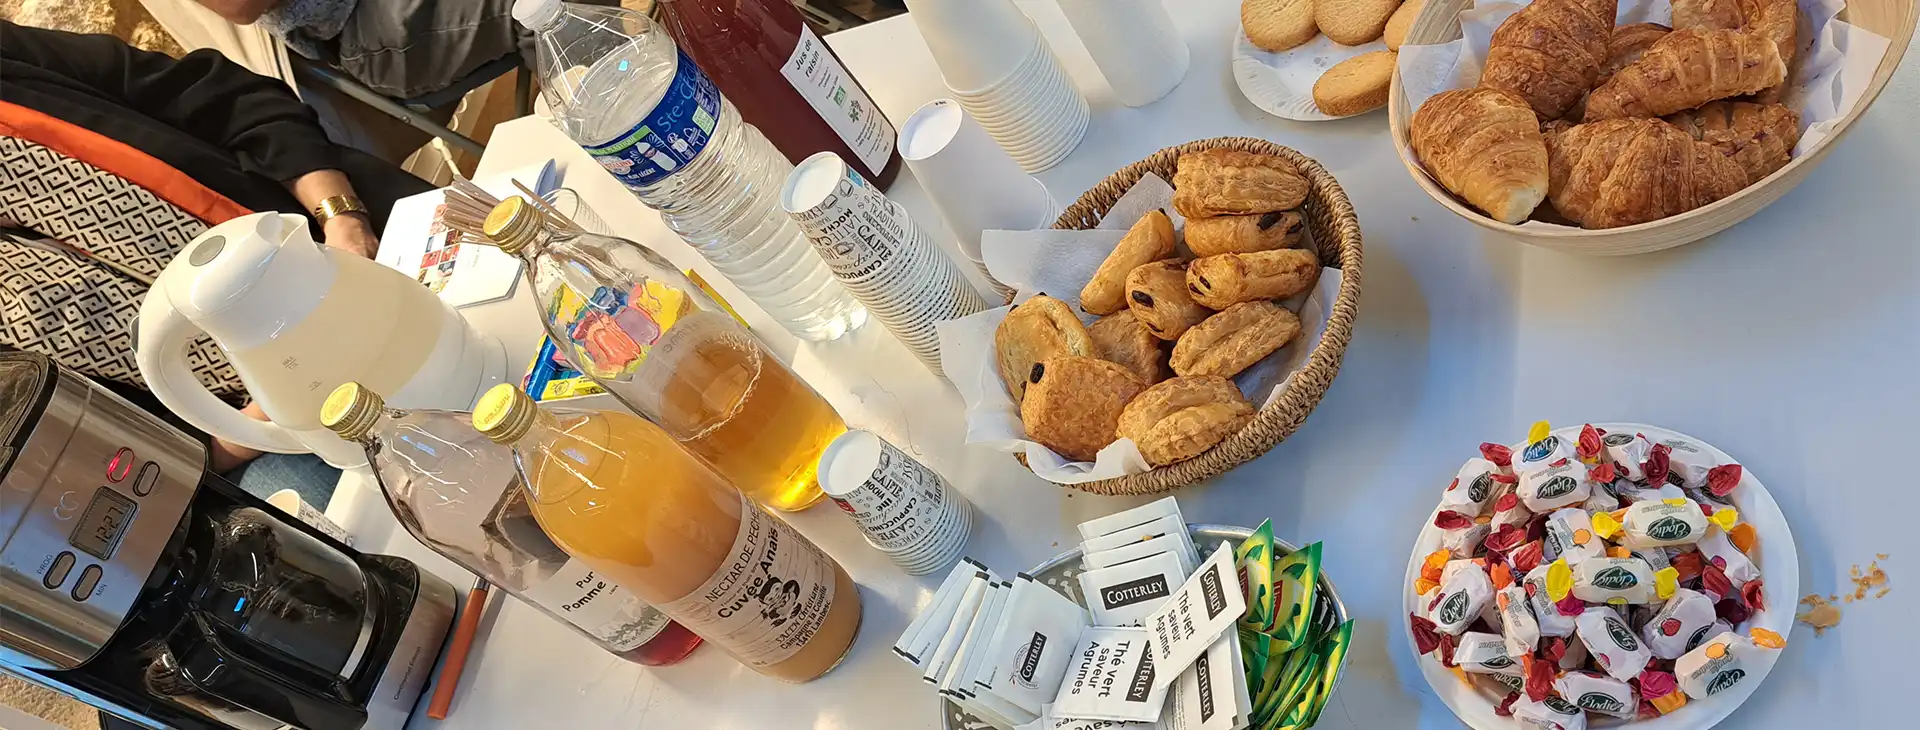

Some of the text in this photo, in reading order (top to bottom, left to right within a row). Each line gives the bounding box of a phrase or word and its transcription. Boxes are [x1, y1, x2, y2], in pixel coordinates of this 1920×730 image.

[795, 39, 812, 70] Jus de
[805, 50, 820, 78] raisin
[820, 208, 853, 234] MOCHA
[832, 214, 862, 242] LATTE
[837, 259, 882, 279] CAPPUCC
[863, 480, 886, 500] MOCHA
[96, 506, 124, 544] 12:27
[869, 497, 917, 532] CAPPUCCINO
[1650, 521, 1690, 541] Elodie
[885, 526, 925, 548] EXPRESSO
[37, 554, 53, 575] PROG
[705, 563, 745, 603] NECTAR
[739, 545, 753, 565] DE
[748, 507, 761, 547] PECHE
[576, 571, 595, 589] Pur
[718, 577, 764, 618] Cuvée
[760, 527, 779, 575] Anaïs
[1596, 571, 1637, 590] Elodie
[95, 583, 107, 597] MIN
[562, 580, 607, 613] Pomme
[799, 583, 820, 621] Christiane
[1107, 581, 1164, 605] COTTERLEY
[1203, 569, 1222, 614] COTTERLEY
[780, 620, 812, 650] Campagne
[810, 611, 817, 621] la
[796, 601, 831, 648] 13410 Lambesc
[1167, 609, 1182, 644] saveur
[1178, 590, 1196, 640] Thé vert
[1156, 614, 1172, 660] Agrumes
[1071, 640, 1100, 695] Agrumes
[1088, 647, 1110, 689] saveur
[1098, 640, 1131, 698] Thé vert
[1197, 657, 1213, 721] COTTERLEY
[1581, 694, 1623, 713] Elodie
